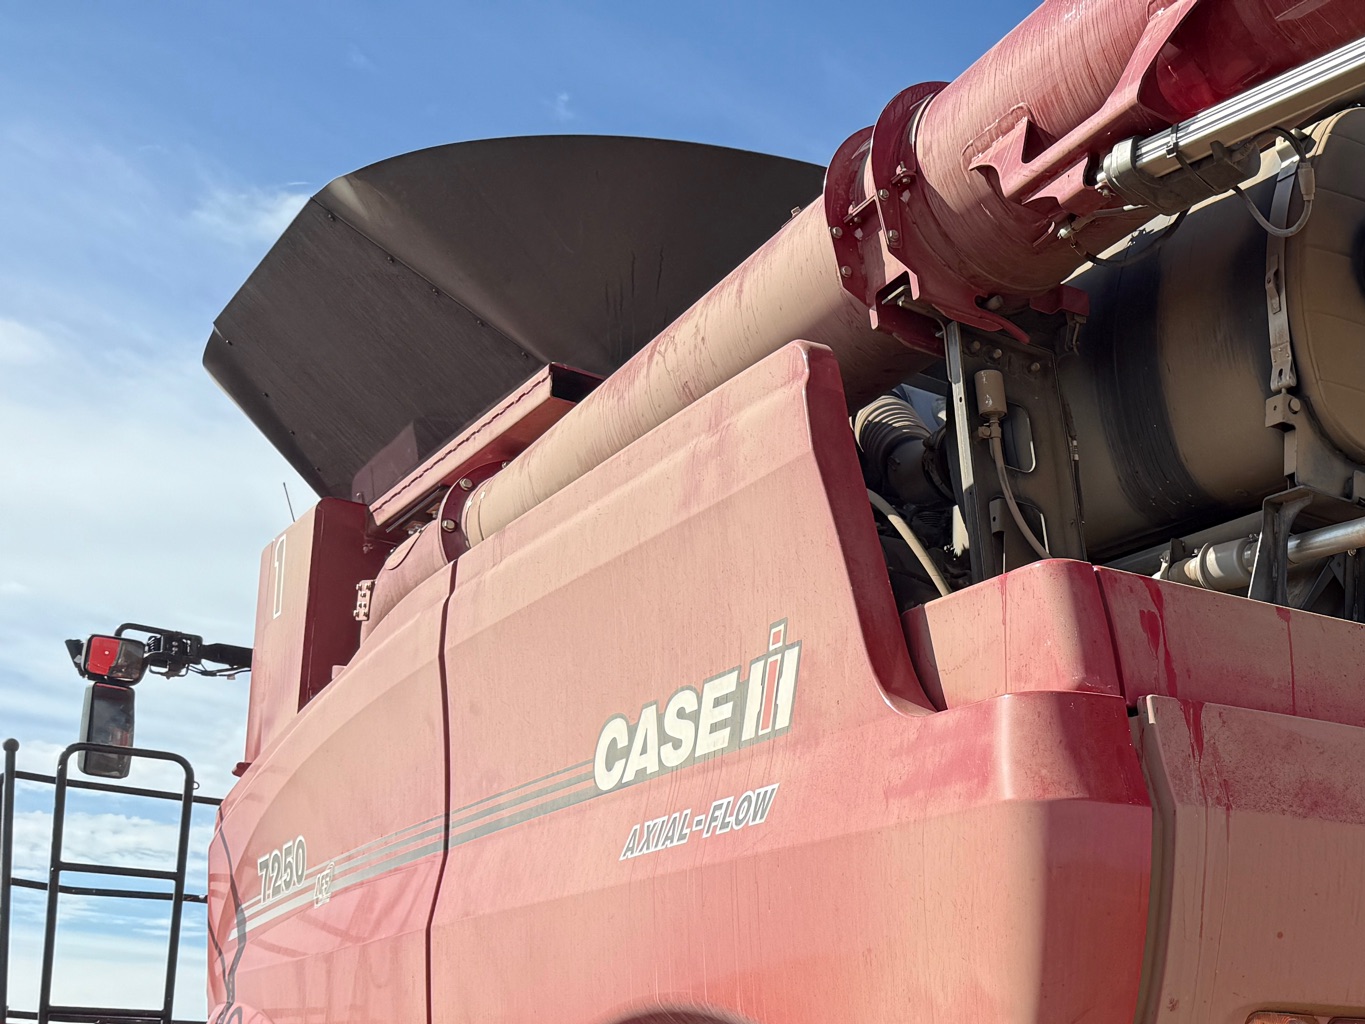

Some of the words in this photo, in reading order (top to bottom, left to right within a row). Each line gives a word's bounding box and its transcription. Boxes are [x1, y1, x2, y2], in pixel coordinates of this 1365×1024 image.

[593, 670, 739, 791] CASE
[619, 783, 779, 861] AXIAL-FLOW
[257, 835, 306, 905] 7250
